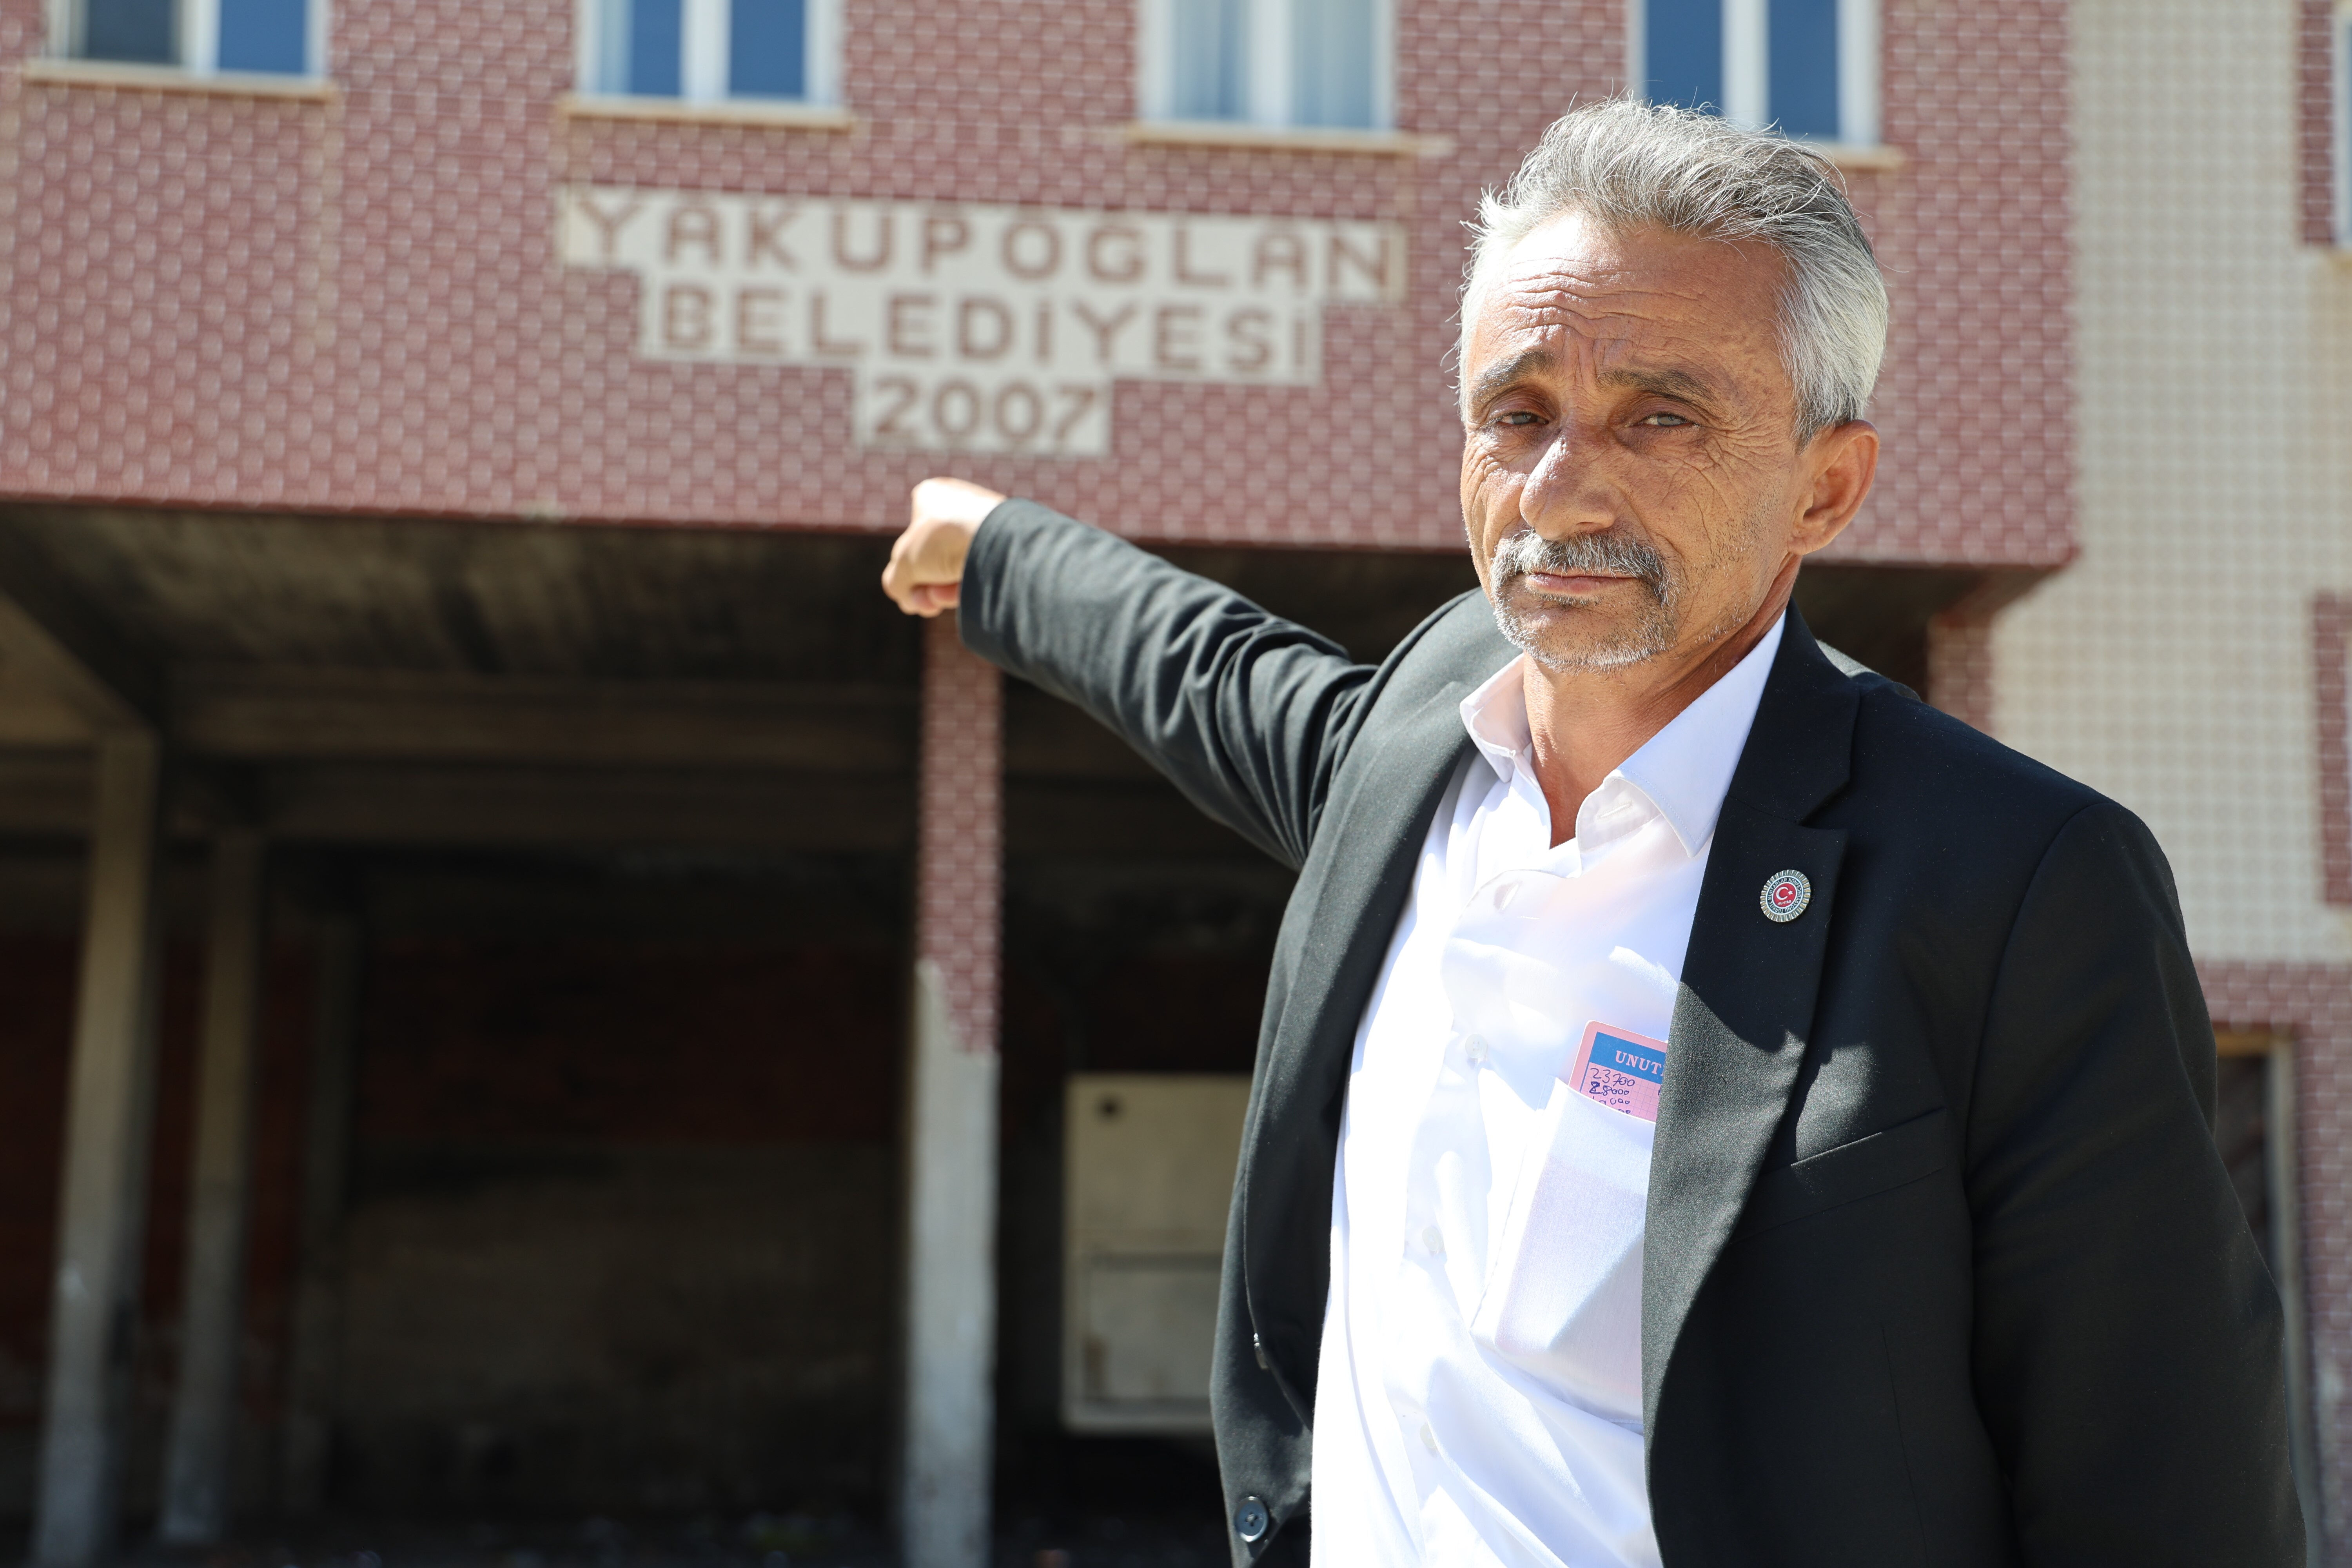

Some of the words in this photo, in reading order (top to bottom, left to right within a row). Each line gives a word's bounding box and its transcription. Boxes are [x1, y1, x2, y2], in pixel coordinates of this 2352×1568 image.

[873, 373, 1096, 441] 2007
[1768, 878, 1787, 900] MUHTARLAR
[1615, 1050, 1663, 1076] UNUT
